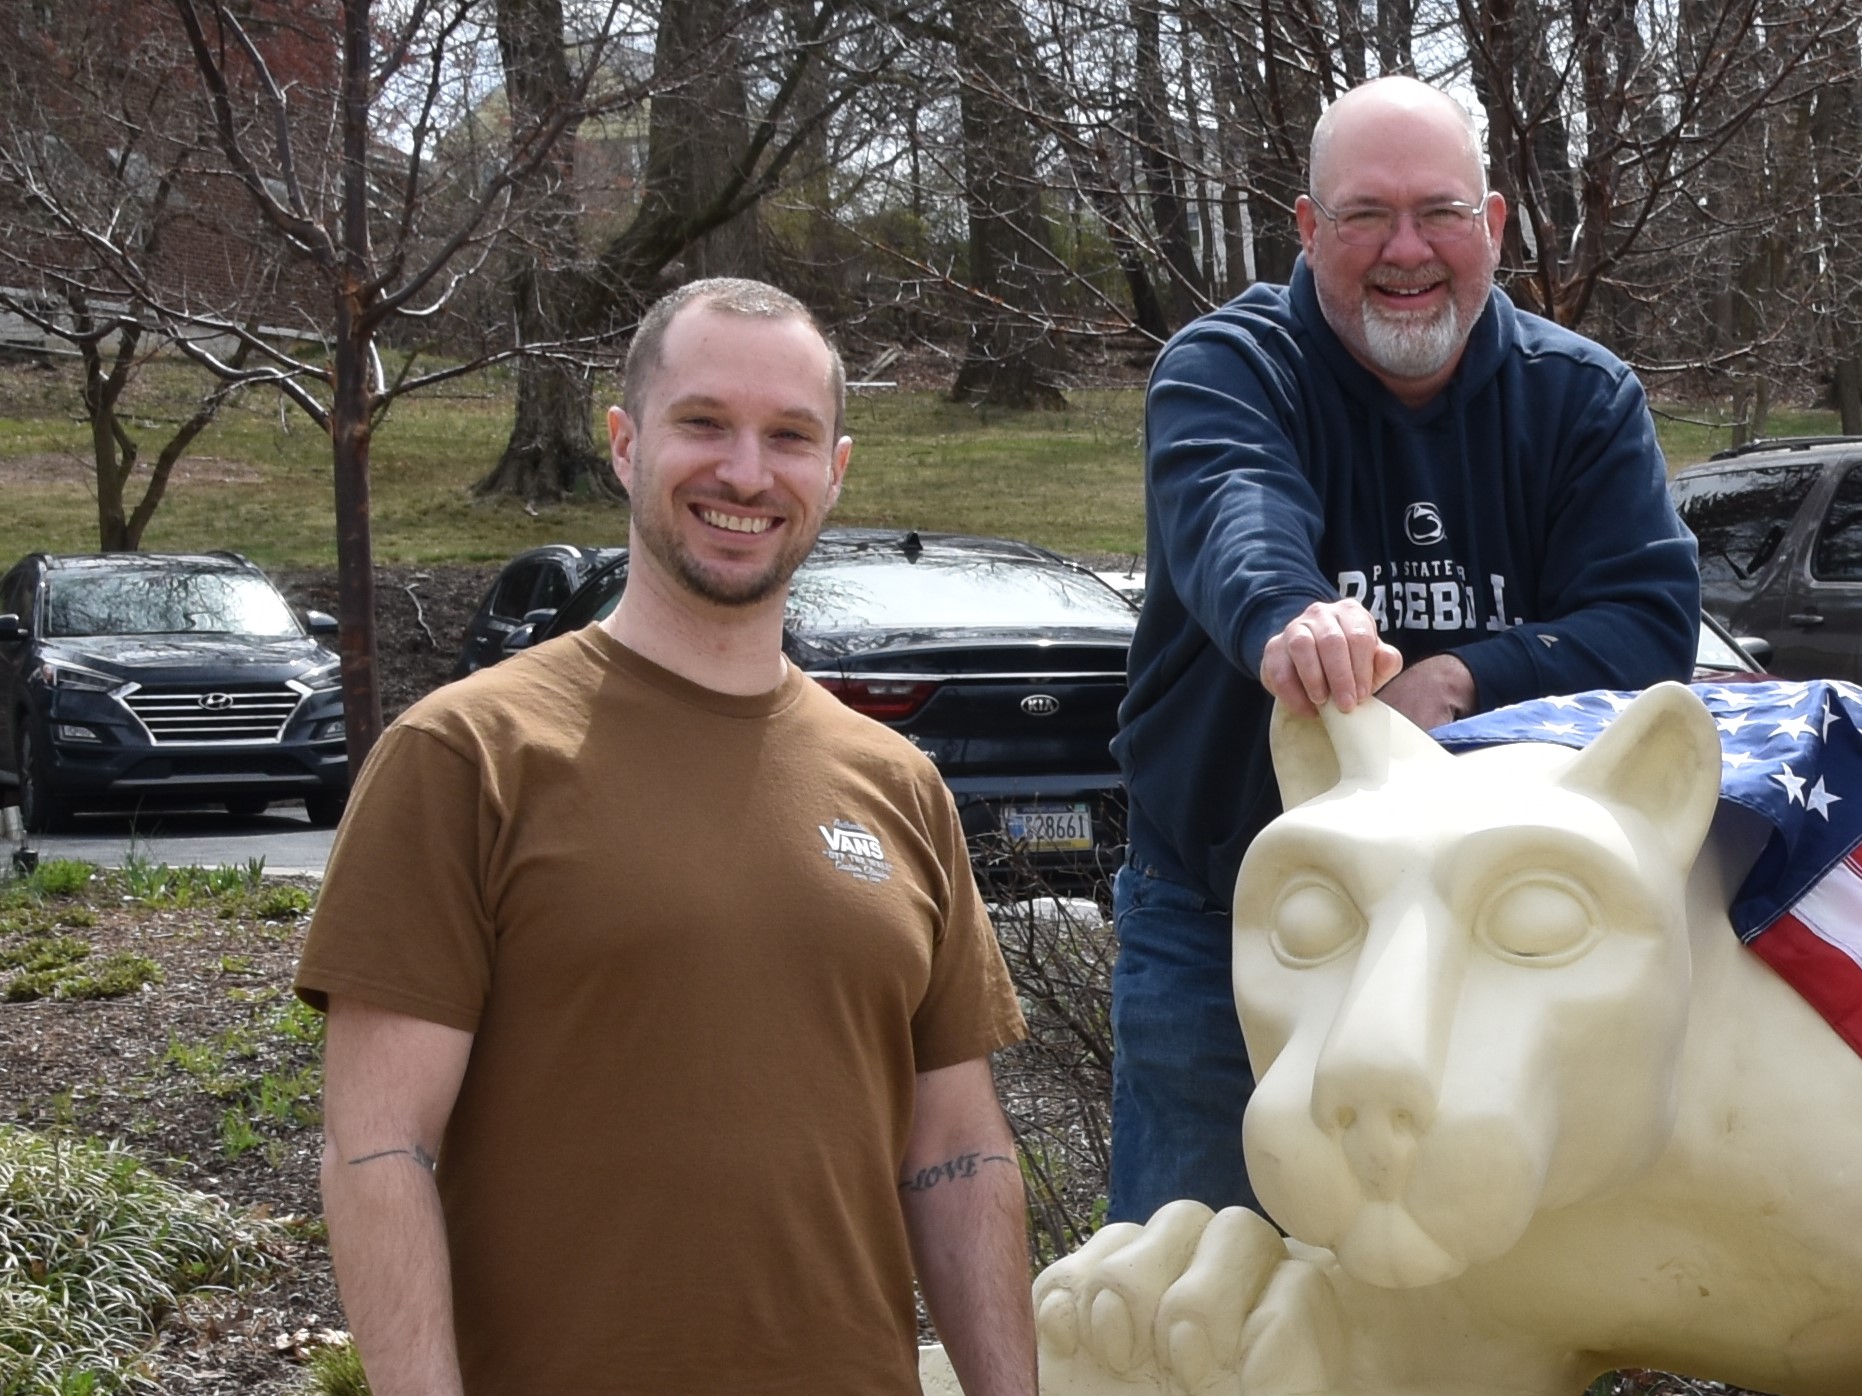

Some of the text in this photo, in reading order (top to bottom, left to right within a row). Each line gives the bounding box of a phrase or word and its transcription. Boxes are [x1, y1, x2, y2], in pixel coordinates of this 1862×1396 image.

[1403, 560, 1453, 577] STATE
[1338, 570, 1524, 632] BASEBAL
[1027, 699, 1054, 712] KIA
[819, 825, 884, 860] VANS
[911, 1153, 980, 1191] LOVE
